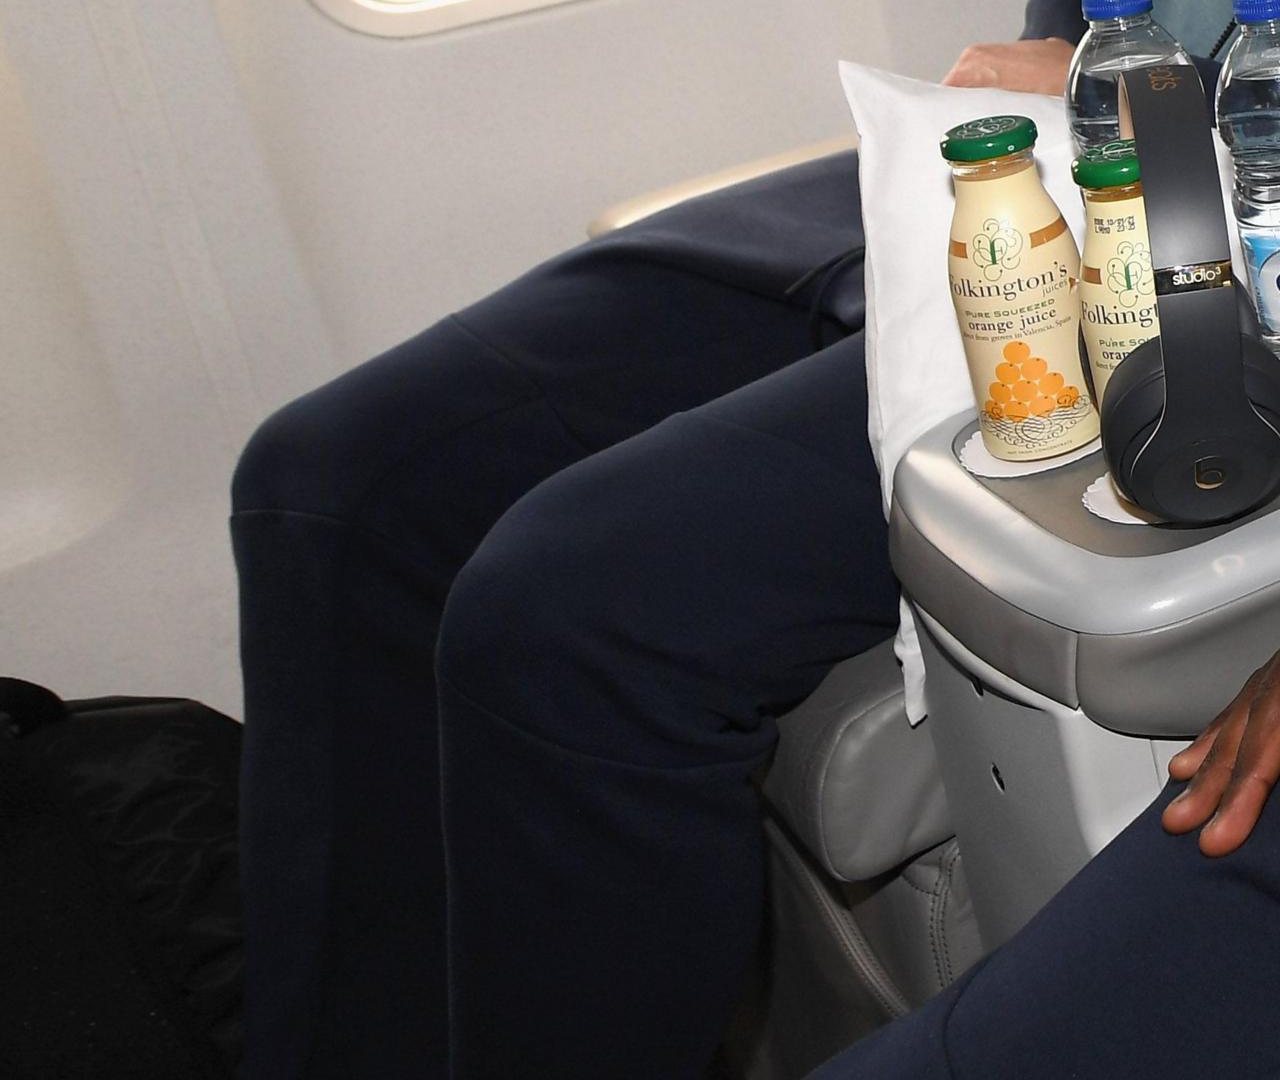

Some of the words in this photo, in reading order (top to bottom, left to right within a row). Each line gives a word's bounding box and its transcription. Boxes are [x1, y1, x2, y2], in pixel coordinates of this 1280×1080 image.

[1042, 279, 1068, 298] juices
[965, 309, 991, 319] PURE
[993, 298, 1055, 317] SQUEEZED
[968, 320, 1014, 334] orange
[1020, 308, 1057, 331] juice
[1098, 338, 1125, 348] PURE
